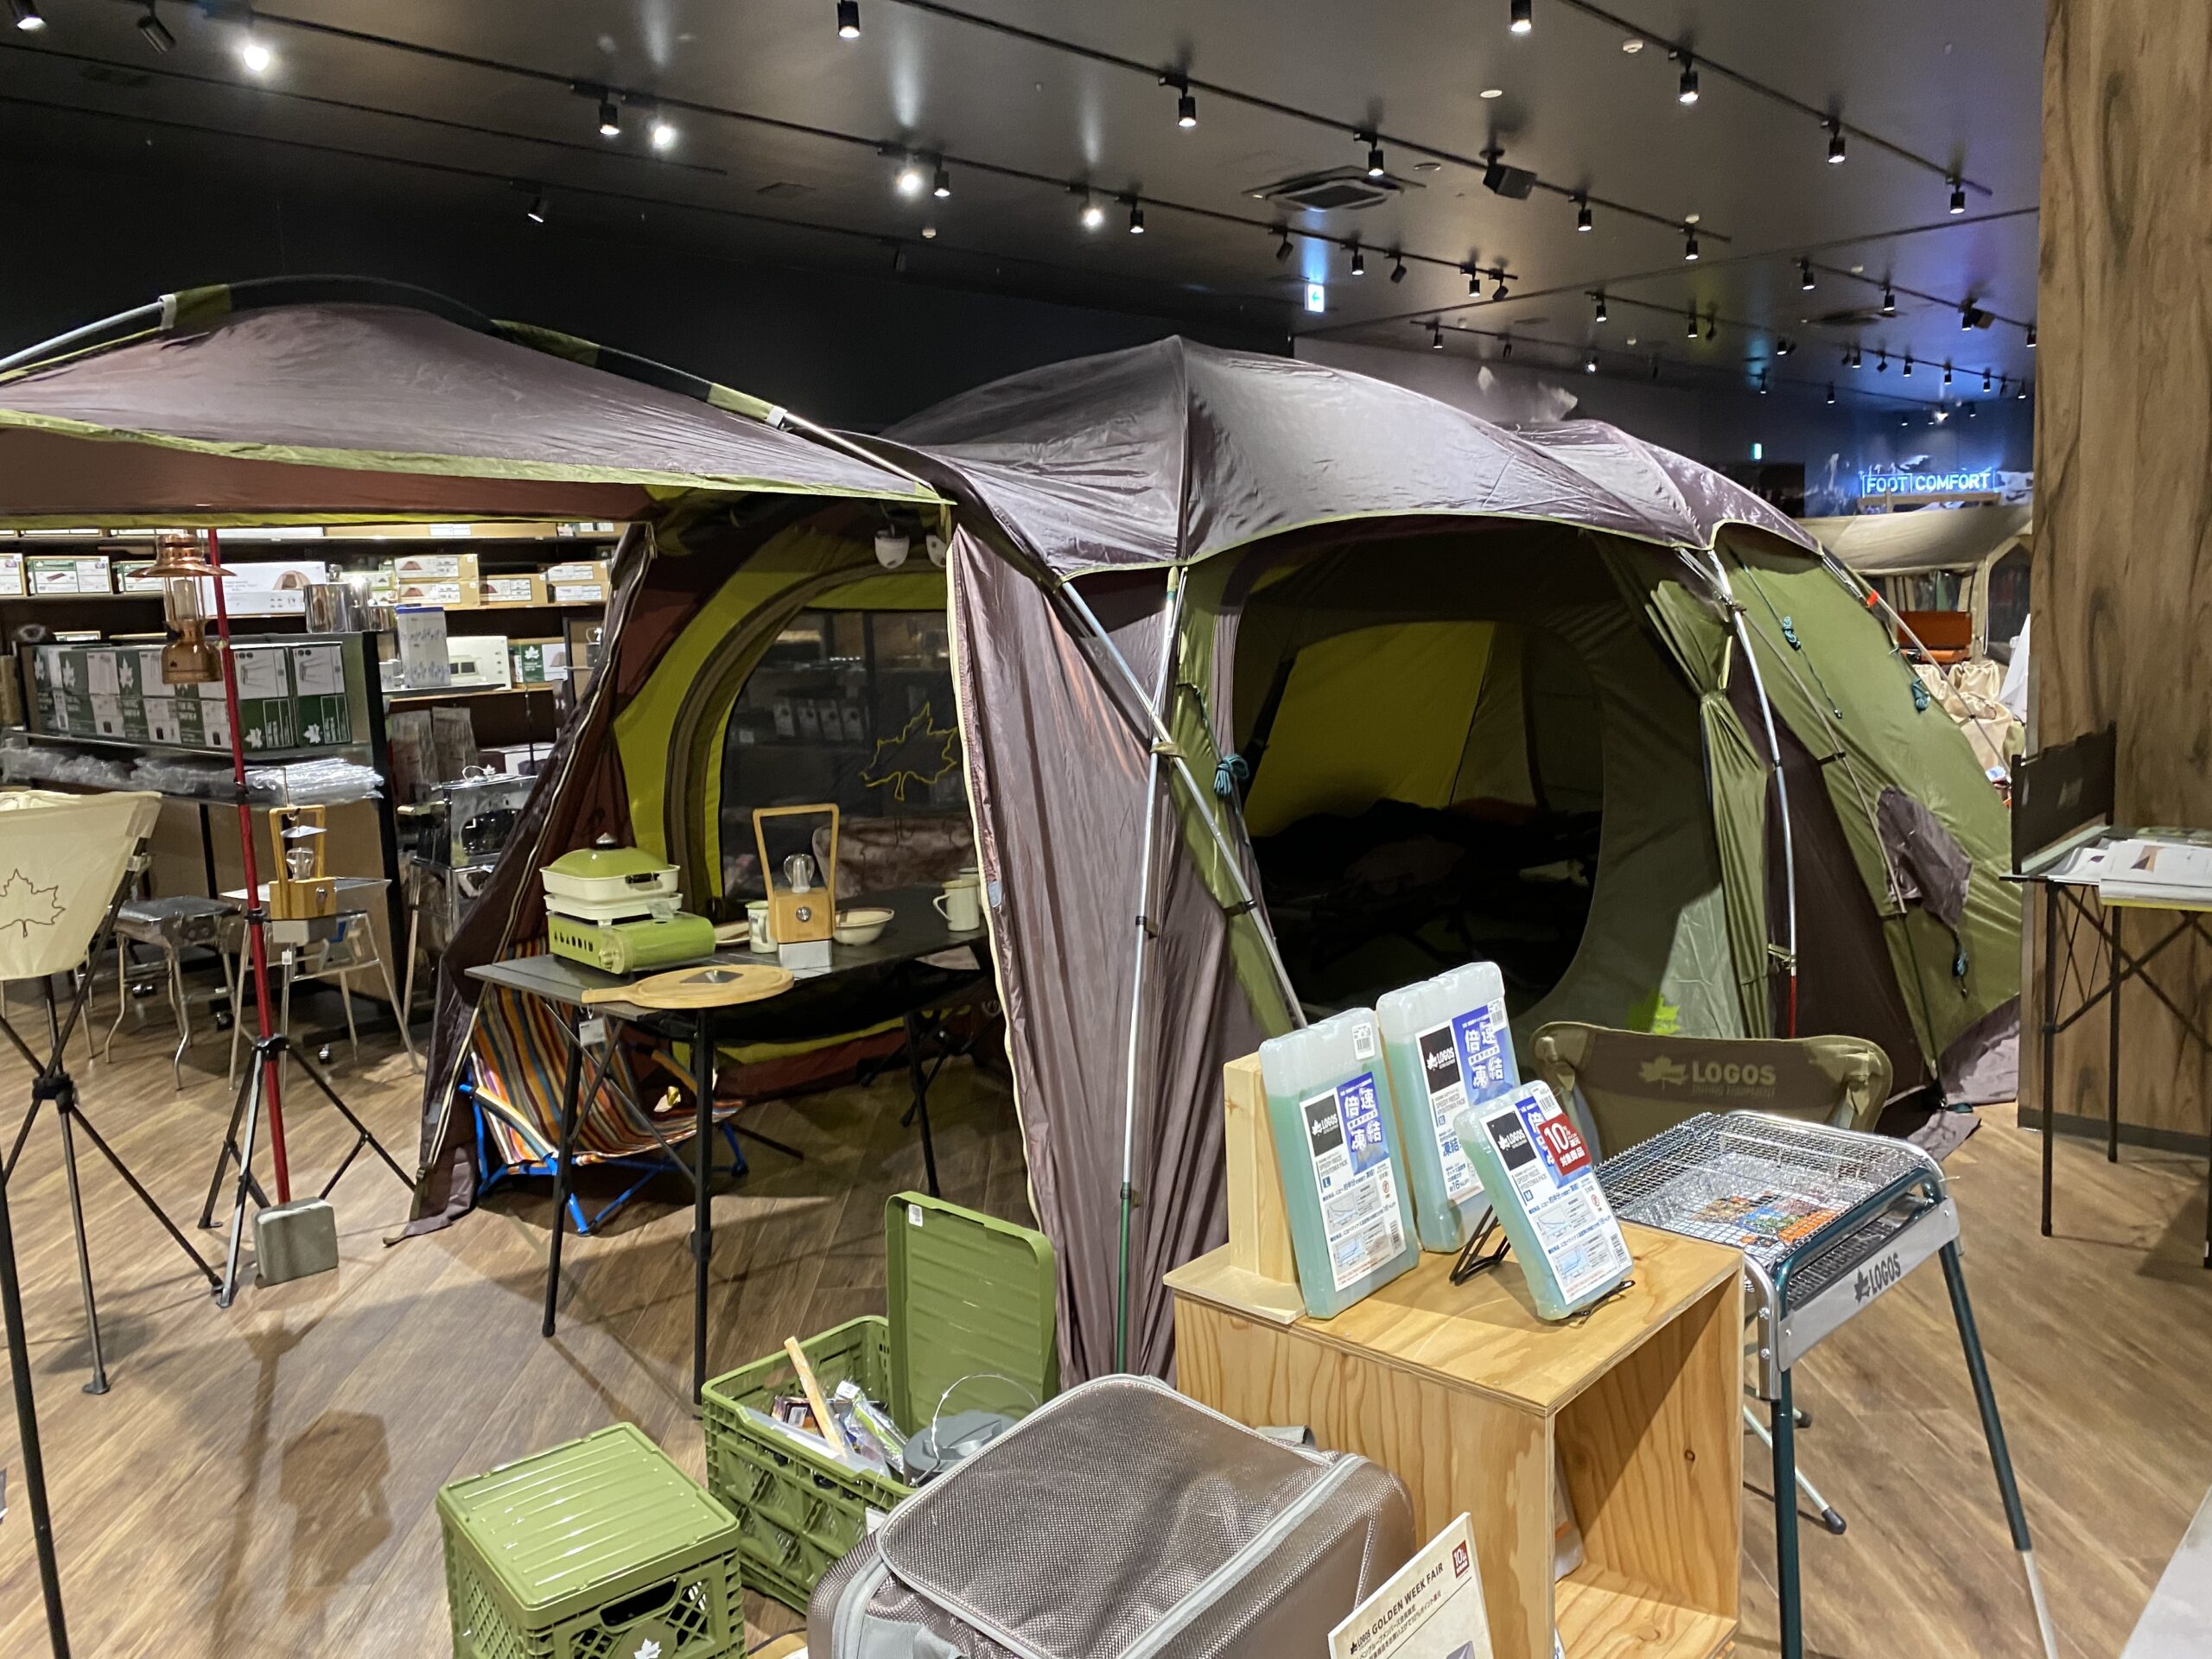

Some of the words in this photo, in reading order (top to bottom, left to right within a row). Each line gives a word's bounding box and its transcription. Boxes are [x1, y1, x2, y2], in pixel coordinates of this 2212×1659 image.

[1866, 476, 1908, 493] FOOT
[1915, 472, 1991, 492] COMFORT
[1436, 1046, 1455, 1064] LOGOS
[1471, 1056, 1503, 1089] 凍結
[1692, 1059, 1777, 1086] LOGOS
[1344, 1087, 1376, 1118] 倍速
[1321, 1113, 1338, 1130] LOGOS
[1351, 1120, 1382, 1152] 凍結
[1508, 1128, 1526, 1146] LOGOS
[1868, 1252, 1902, 1294] LOGOS
[1357, 1629, 1371, 1647] LOGOS
[1371, 1599, 1404, 1636] GOLDEN
[1404, 1579, 1426, 1605] WEEK
[1427, 1562, 1444, 1586] FAIR
